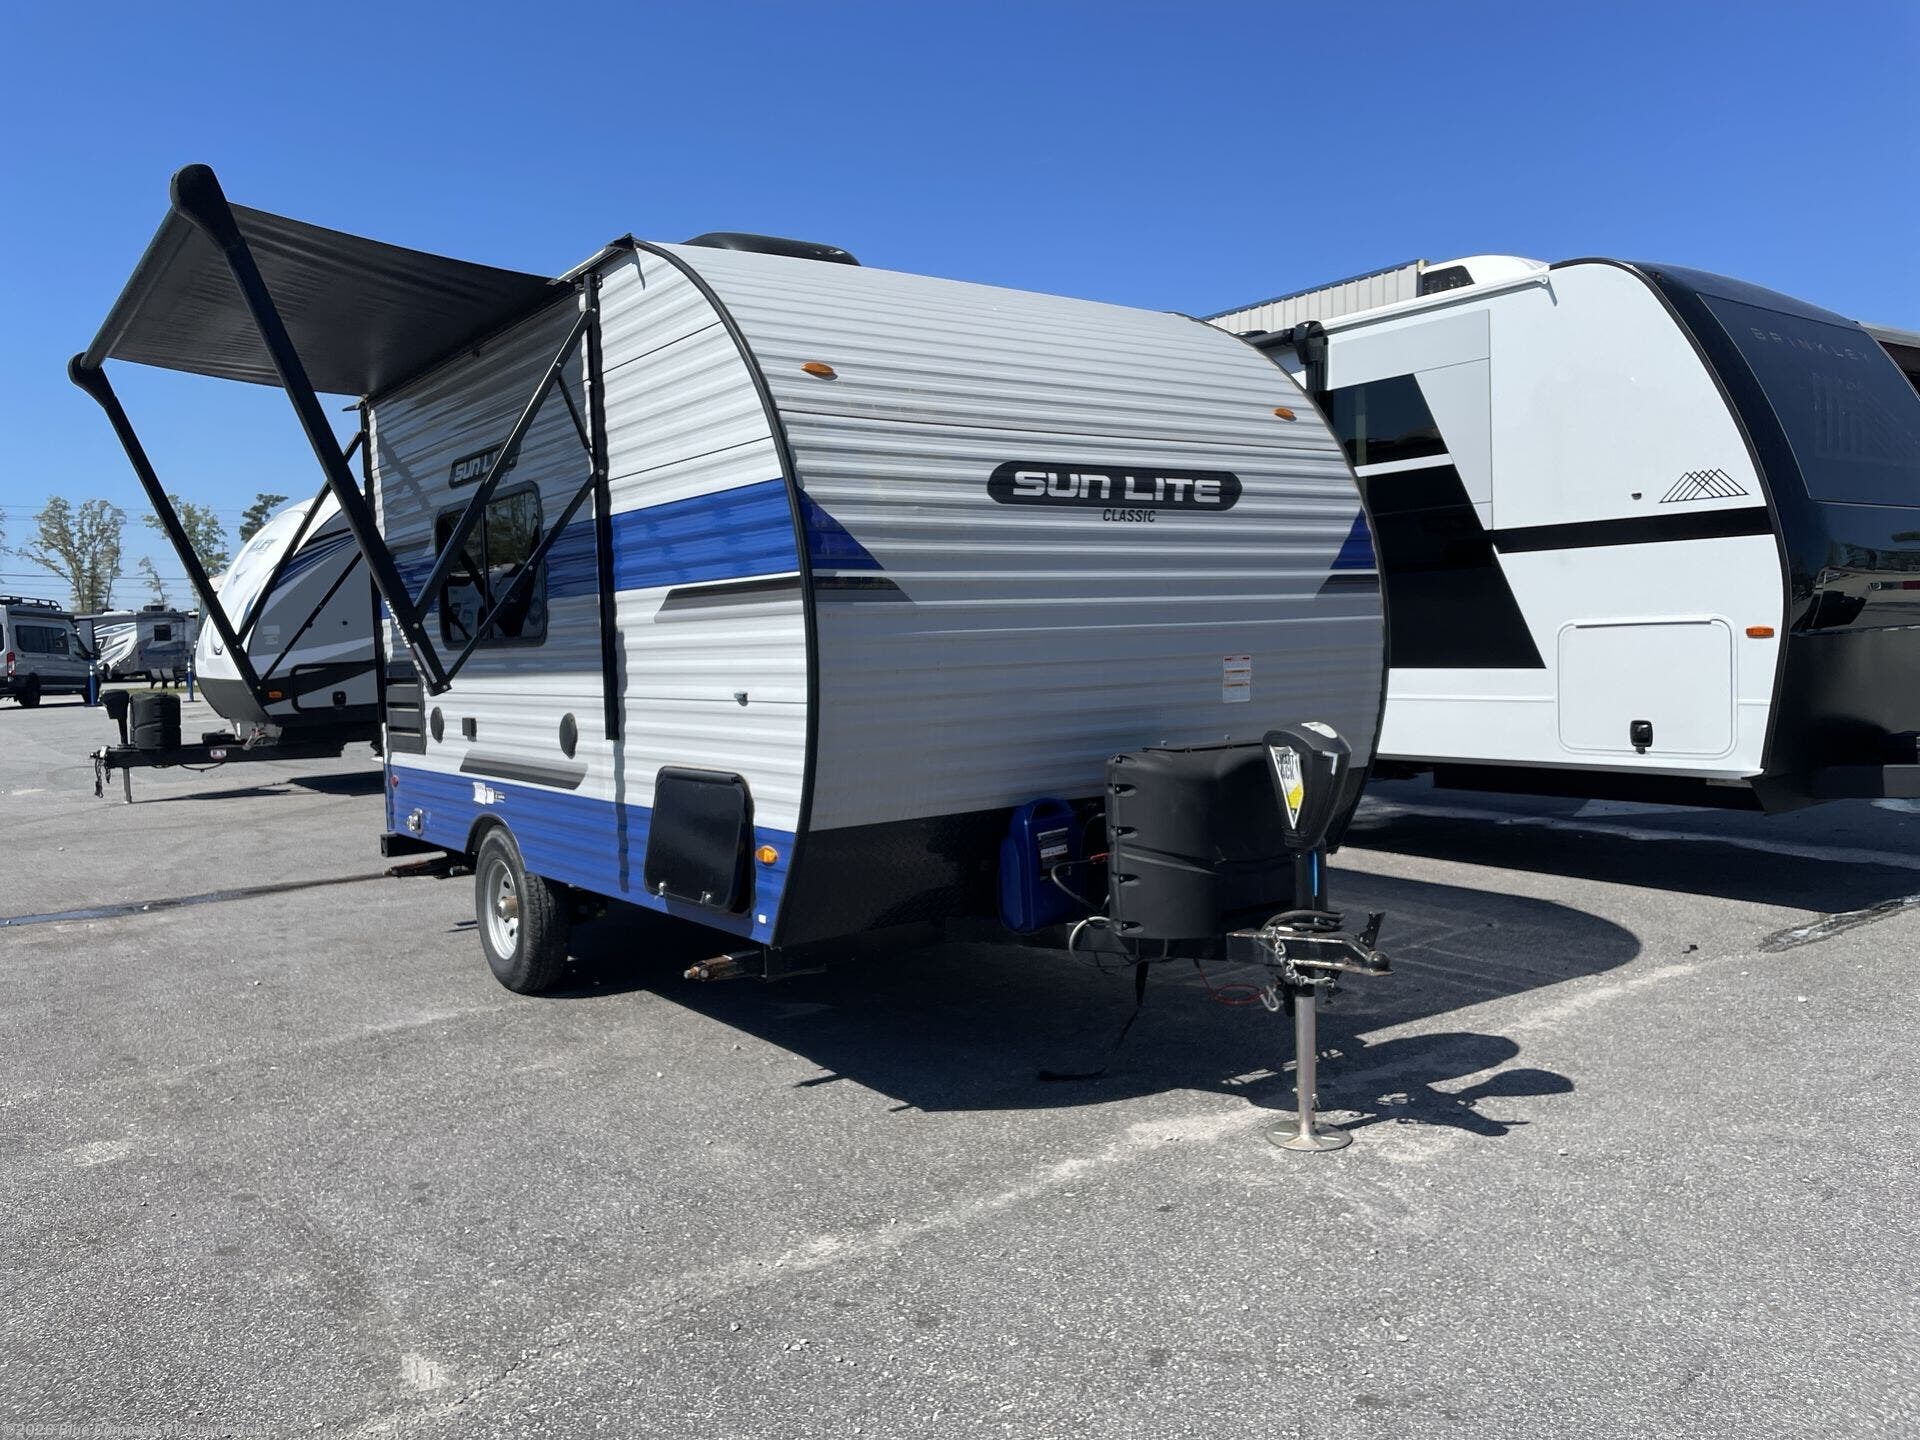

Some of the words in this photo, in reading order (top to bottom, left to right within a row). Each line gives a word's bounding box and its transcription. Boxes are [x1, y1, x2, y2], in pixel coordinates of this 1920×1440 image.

[454, 456, 481, 482] SUN
[1012, 471, 1110, 499] SUN
[1124, 476, 1221, 503] LITE
[1102, 508, 1156, 523] CLASSIC
